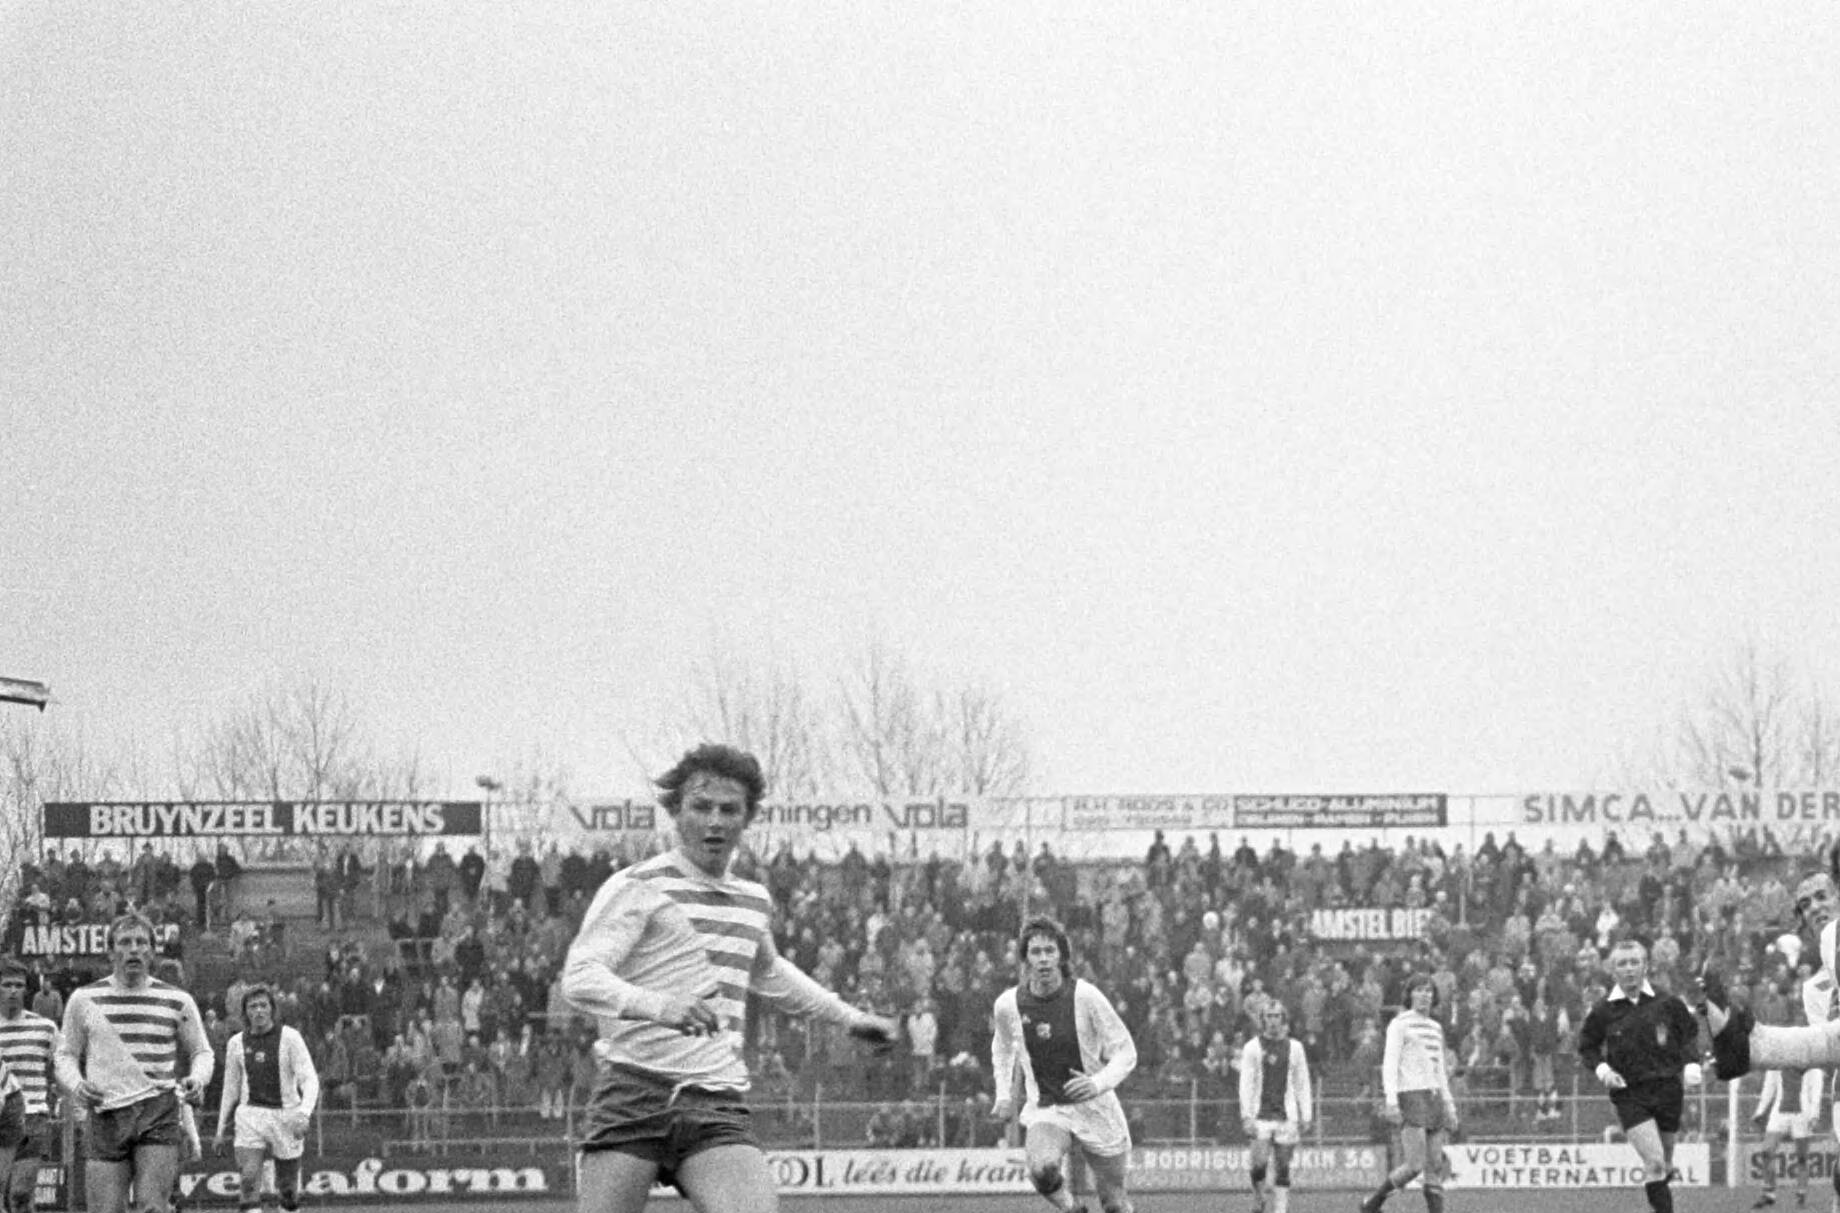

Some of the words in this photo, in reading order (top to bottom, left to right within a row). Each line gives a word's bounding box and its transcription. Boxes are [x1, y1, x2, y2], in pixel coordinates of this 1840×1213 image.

[1776, 792, 1840, 820] DER
[89, 804, 284, 836] BRUYNZEEL
[292, 804, 444, 834] KEUKENS
[1467, 1147, 1587, 1165] VOETBAL
[905, 1158, 948, 1183] die
[957, 1157, 1026, 1183] kran
[1482, 1166, 1699, 1185] INTERNATIOAL
